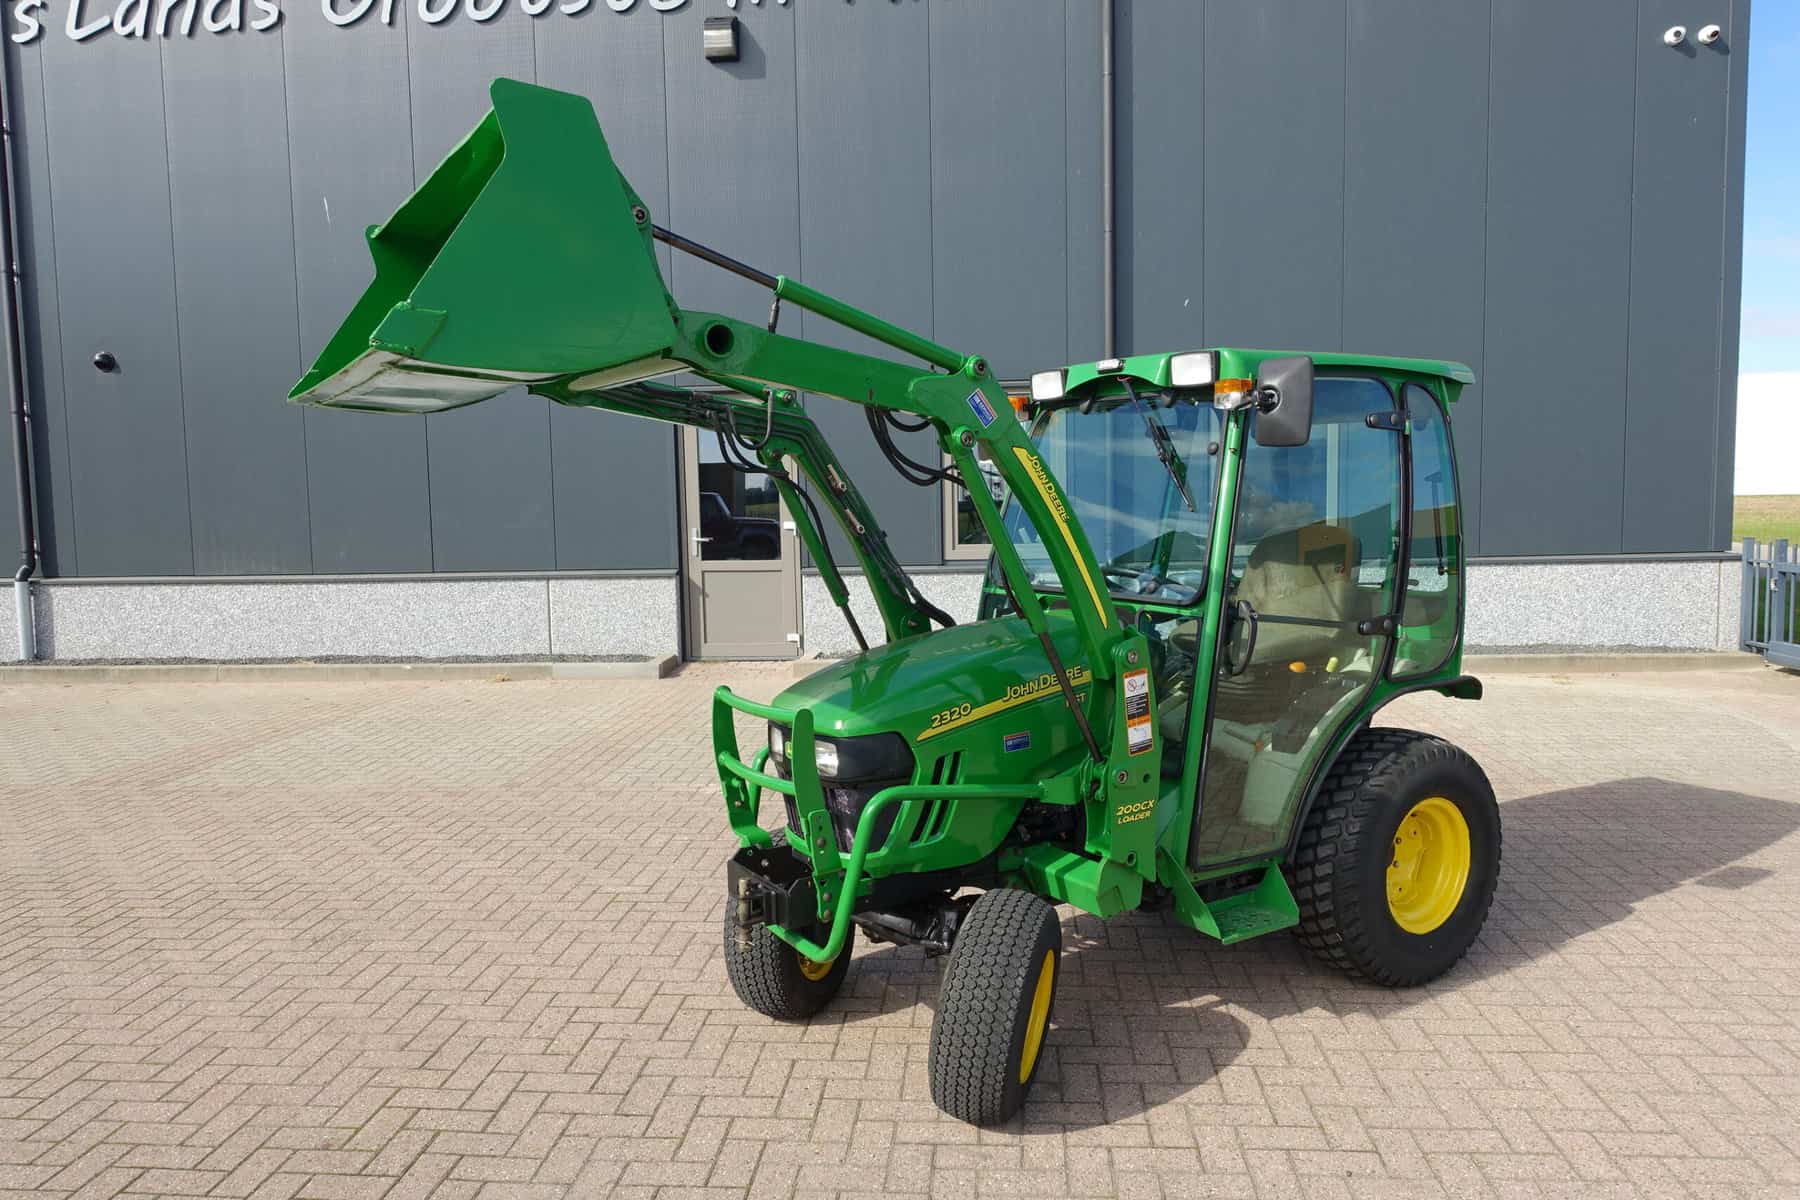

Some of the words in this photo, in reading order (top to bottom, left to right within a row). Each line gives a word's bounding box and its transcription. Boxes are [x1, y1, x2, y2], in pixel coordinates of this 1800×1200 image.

[1027, 454, 1049, 485] JOHN
[1045, 483, 1070, 522] DEERE
[1002, 680, 1040, 701] JOHN
[1039, 666, 1083, 689] DERE
[931, 703, 972, 728] 2320
[1116, 799, 1155, 816] 200CX
[1117, 810, 1152, 825] LOADER
